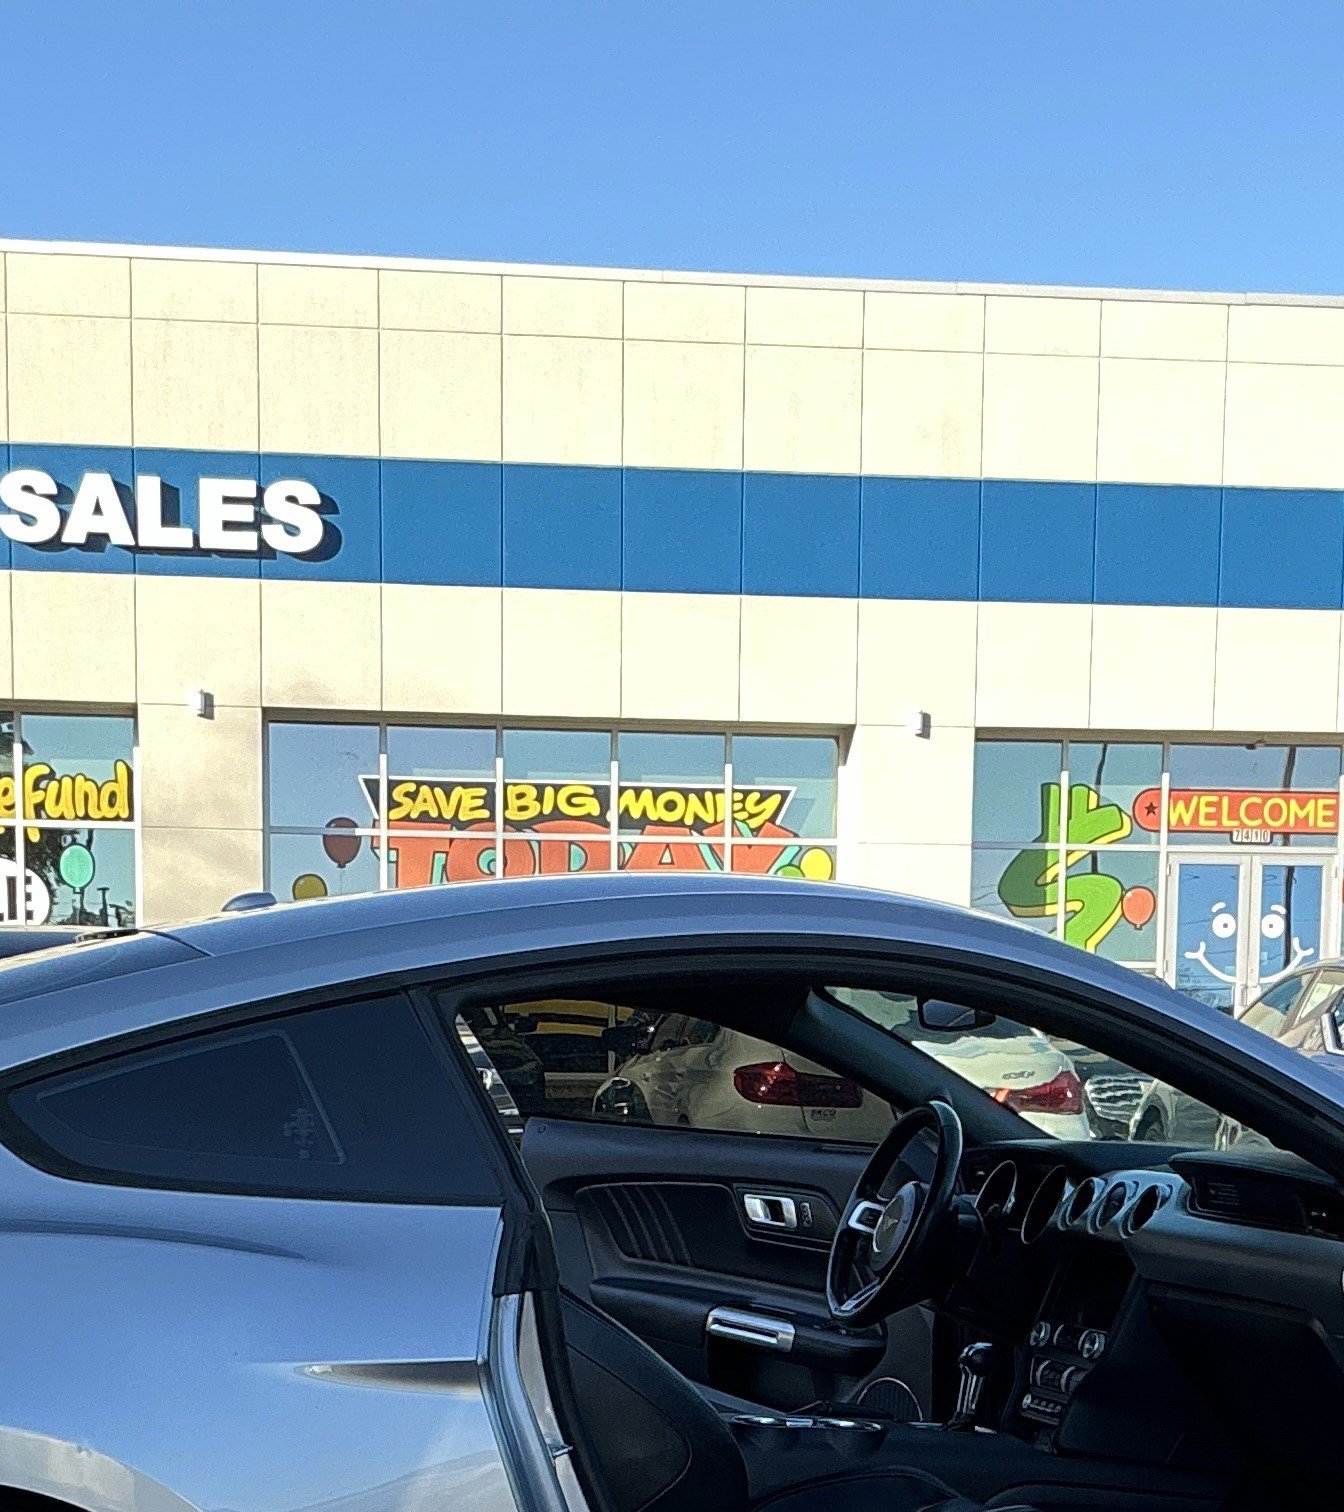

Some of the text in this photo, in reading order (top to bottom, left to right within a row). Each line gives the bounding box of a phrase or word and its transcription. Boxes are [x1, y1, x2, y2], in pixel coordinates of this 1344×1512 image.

[390, 782, 781, 828] SAVE BIG MONEY
[1170, 796, 1337, 828] WELCOME
[372, 820, 801, 889] TODAY
[1234, 829, 1269, 841] 7410
